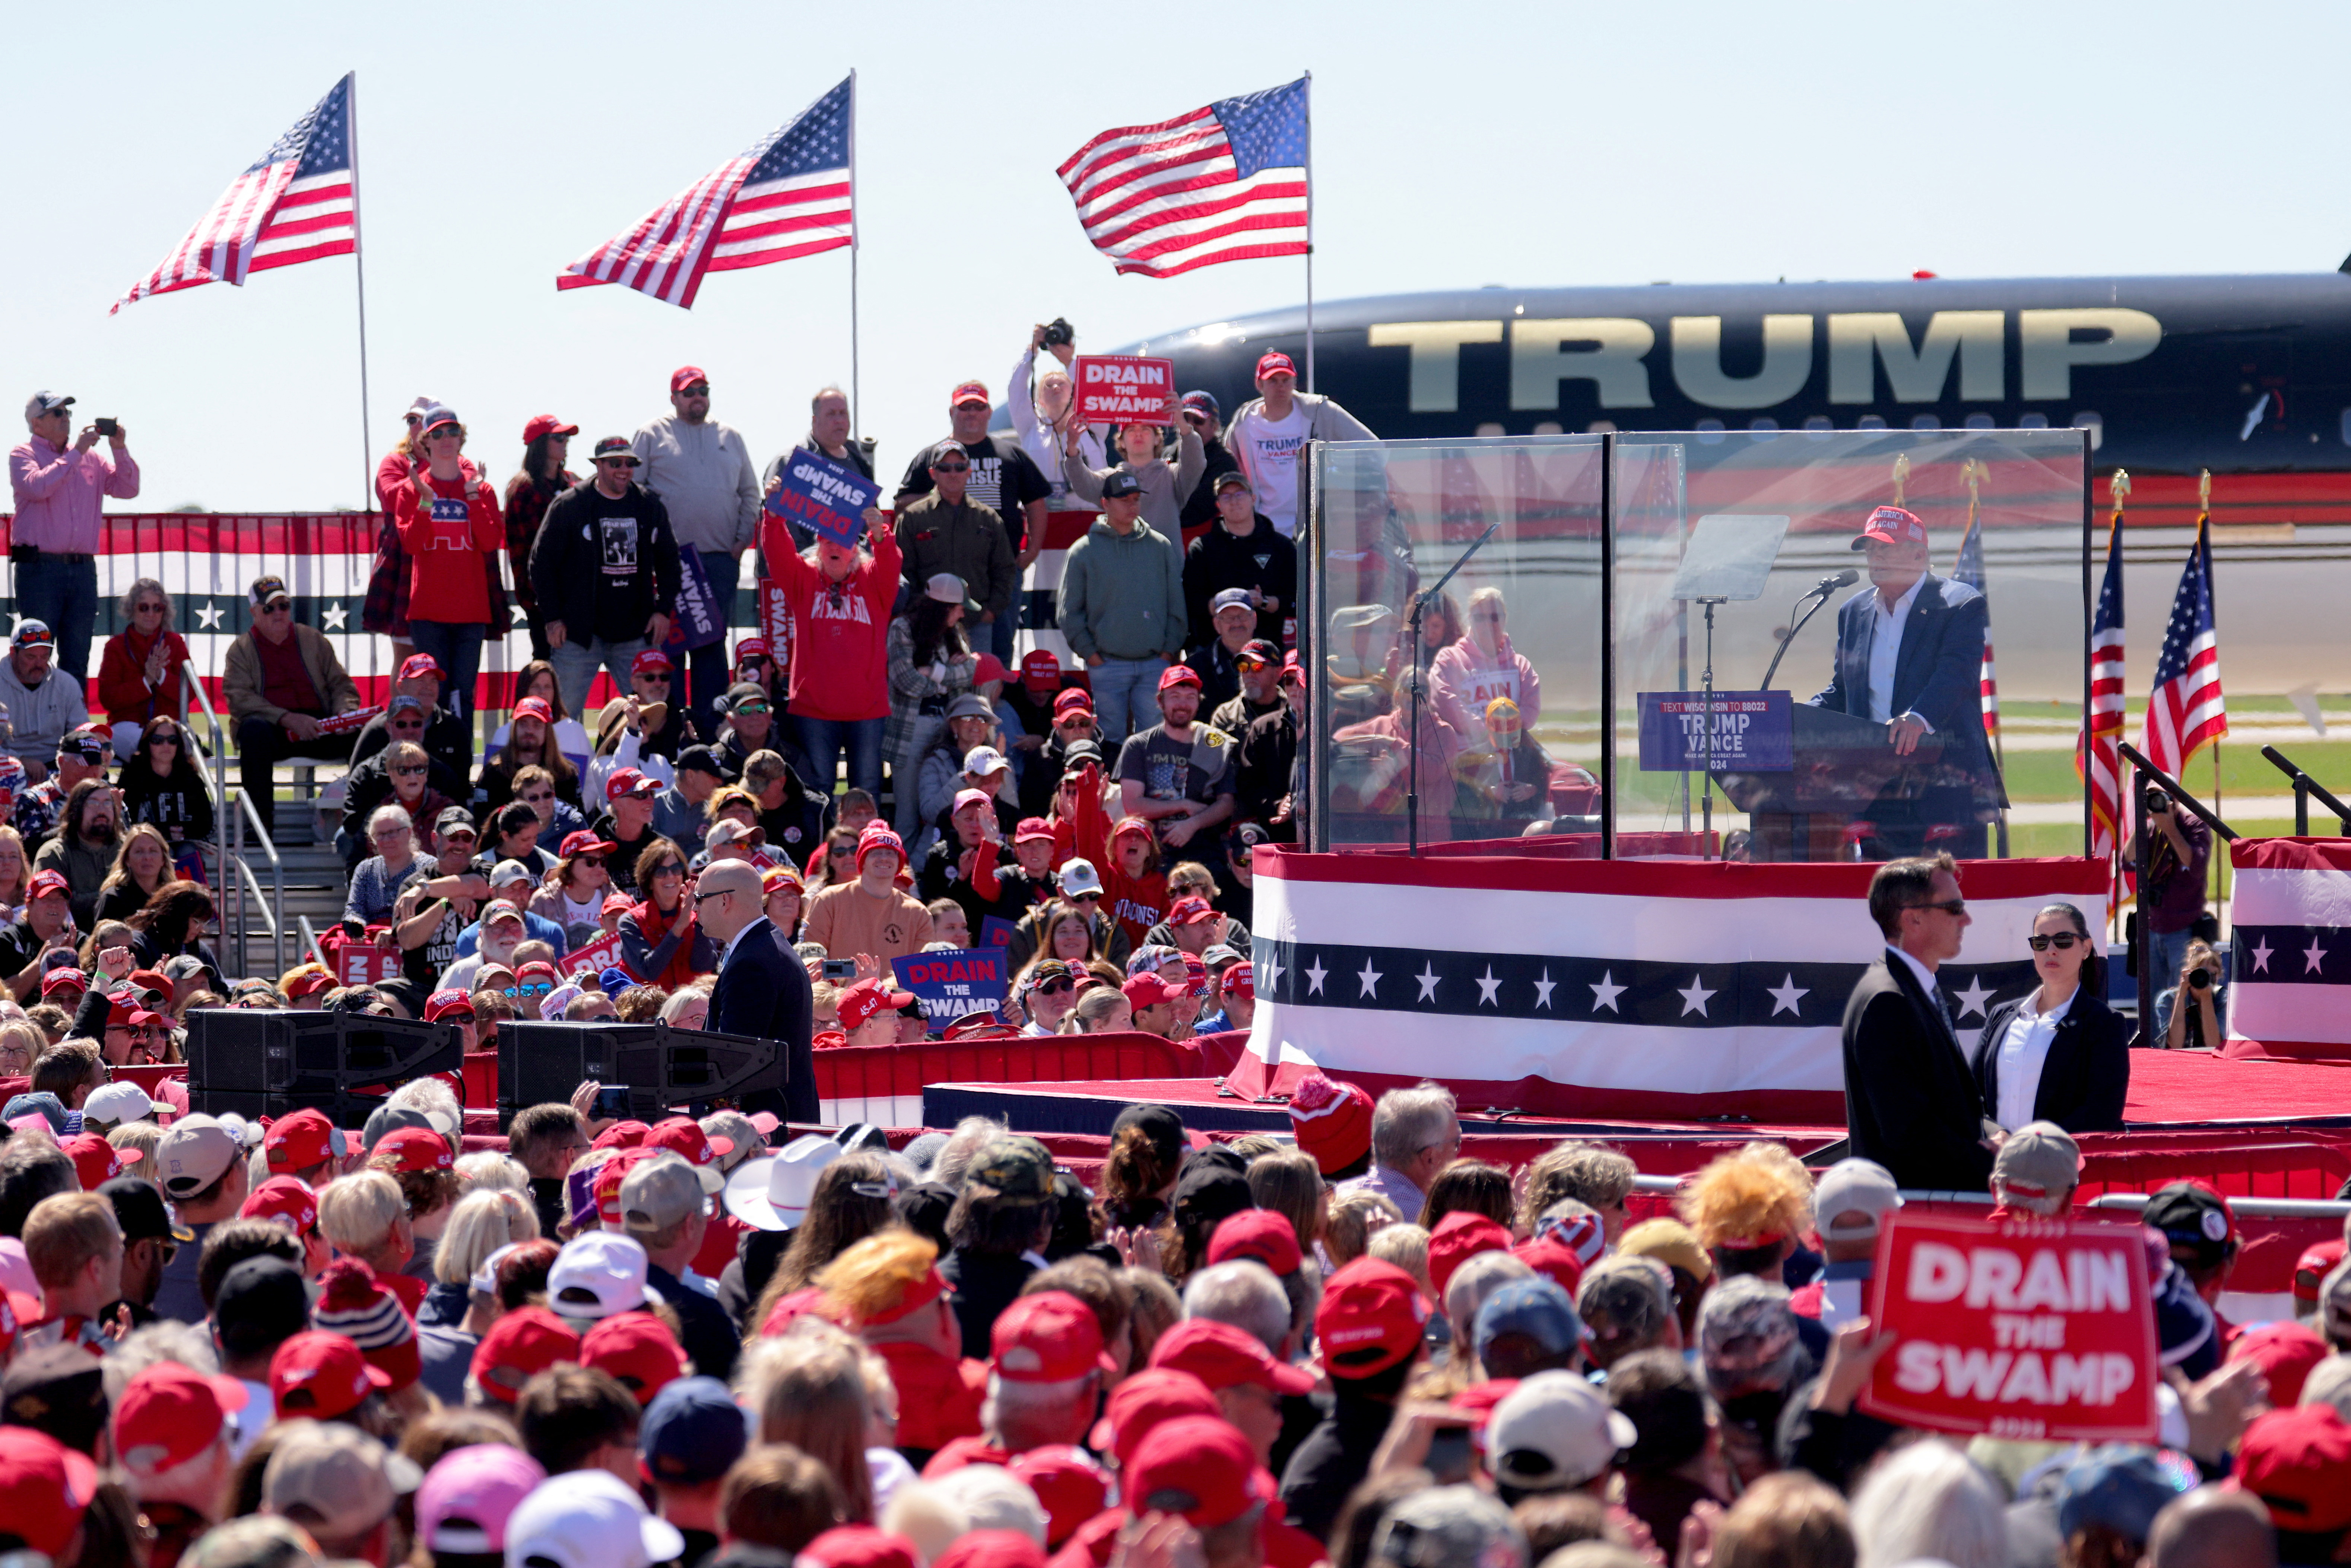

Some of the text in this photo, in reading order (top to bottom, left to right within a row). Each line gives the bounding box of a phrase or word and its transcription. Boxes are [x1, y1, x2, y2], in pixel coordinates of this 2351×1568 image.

[1369, 308, 2163, 412] TRUMP
[1086, 365, 1164, 385] DRAIN
[1113, 385, 1138, 396] THE
[1085, 396, 1164, 412] SWAMP
[1267, 450, 1297, 458] VANCE
[982, 457, 1002, 470] UP
[793, 463, 867, 507] SWAMP
[810, 487, 834, 507] THE
[779, 488, 853, 537] DRAIN
[1878, 520, 1899, 530] AGAIN
[770, 587, 789, 666] SWAMP
[1663, 702, 1766, 712] TEXT WISCNSIN TO 88022
[1679, 714, 1751, 734] TRUMP
[1688, 735, 1743, 752] VANCE
[1153, 753, 1169, 764] I'M
[1710, 760, 1727, 770] 024
[877, 836, 902, 850] 202
[908, 960, 997, 984] DRAIN
[432, 990, 459, 1003] TRUMP
[943, 984, 971, 996] THE
[437, 993, 461, 1007] VANCE
[860, 997, 878, 1016] 45-47
[923, 998, 1000, 1018] SWAMP
[1907, 1241, 2131, 1312] DRAIN
[1992, 1315, 2066, 1349] THE
[1895, 1342, 2135, 1407] SWAMP
